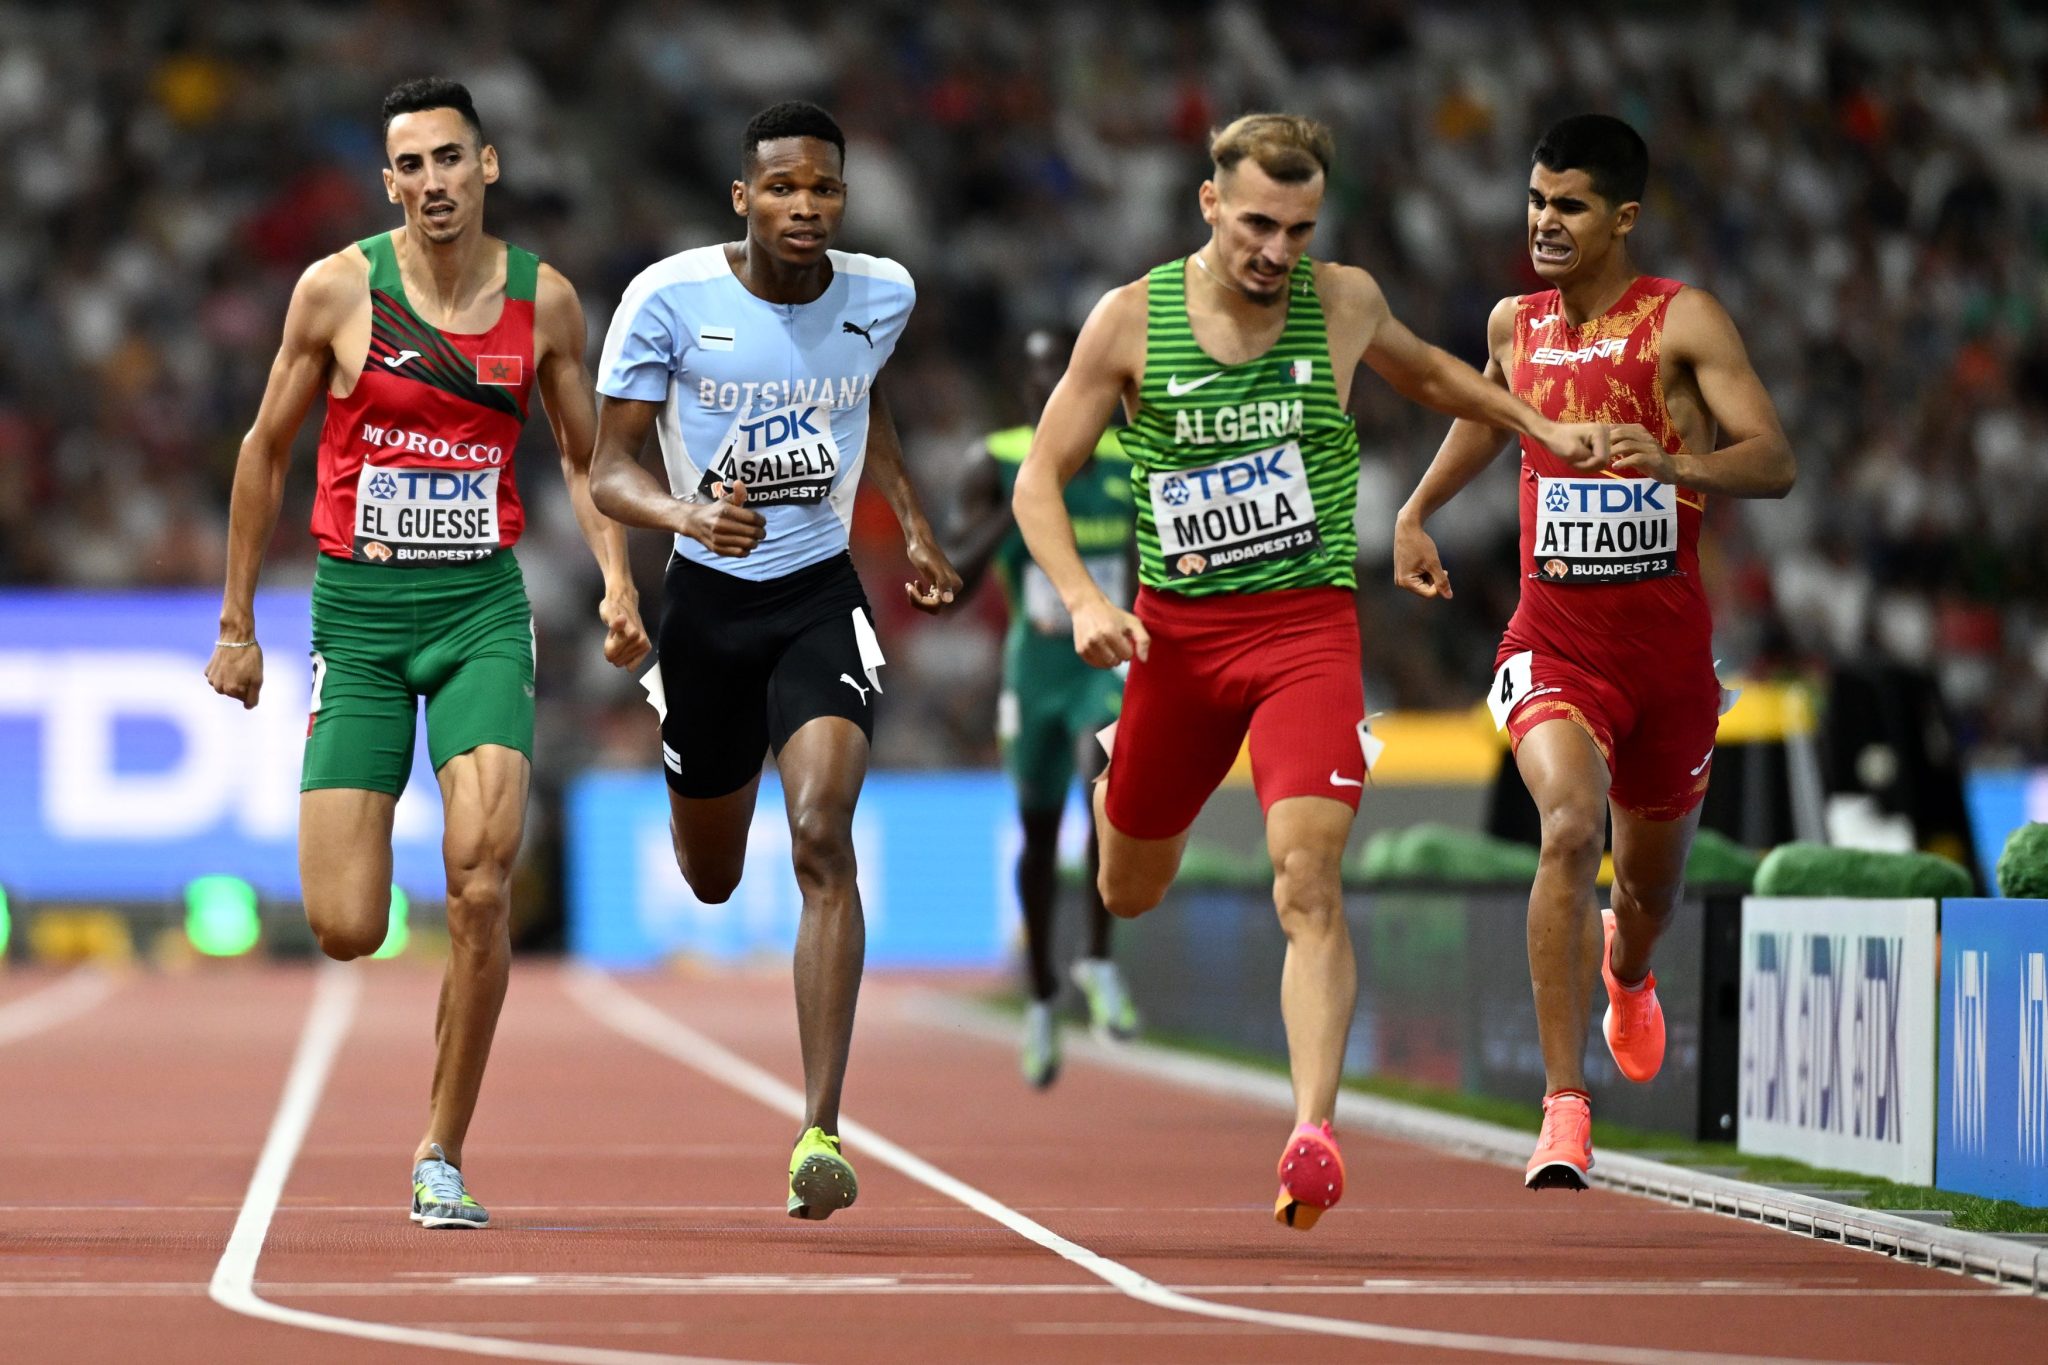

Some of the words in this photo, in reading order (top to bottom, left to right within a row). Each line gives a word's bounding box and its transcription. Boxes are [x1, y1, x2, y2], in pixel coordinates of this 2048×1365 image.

[1530, 338, 1629, 366] ESPAÑA
[700, 374, 870, 412] BOTSWANA
[739, 406, 821, 452] TDK
[1174, 400, 1304, 445] ALGERIA
[361, 424, 502, 464] MOROCCO
[718, 443, 835, 485] ASALELA
[1186, 448, 1292, 500] TDK
[397, 472, 491, 502] TDK
[747, 486, 817, 502] UDAPEST
[1569, 481, 1666, 513] TDK
[362, 504, 389, 537] EL
[397, 508, 490, 540] GUESSE
[1173, 492, 1297, 548] MOULA
[1541, 518, 1668, 553] ATTAOUI
[397, 549, 474, 561] BUDAPEST
[1210, 535, 1292, 567] BUDAPEST
[1294, 530, 1313, 546] 23
[1572, 562, 1650, 575] BUDAPEST
[1651, 559, 1668, 571] 23
[1501, 667, 1514, 704] 4
